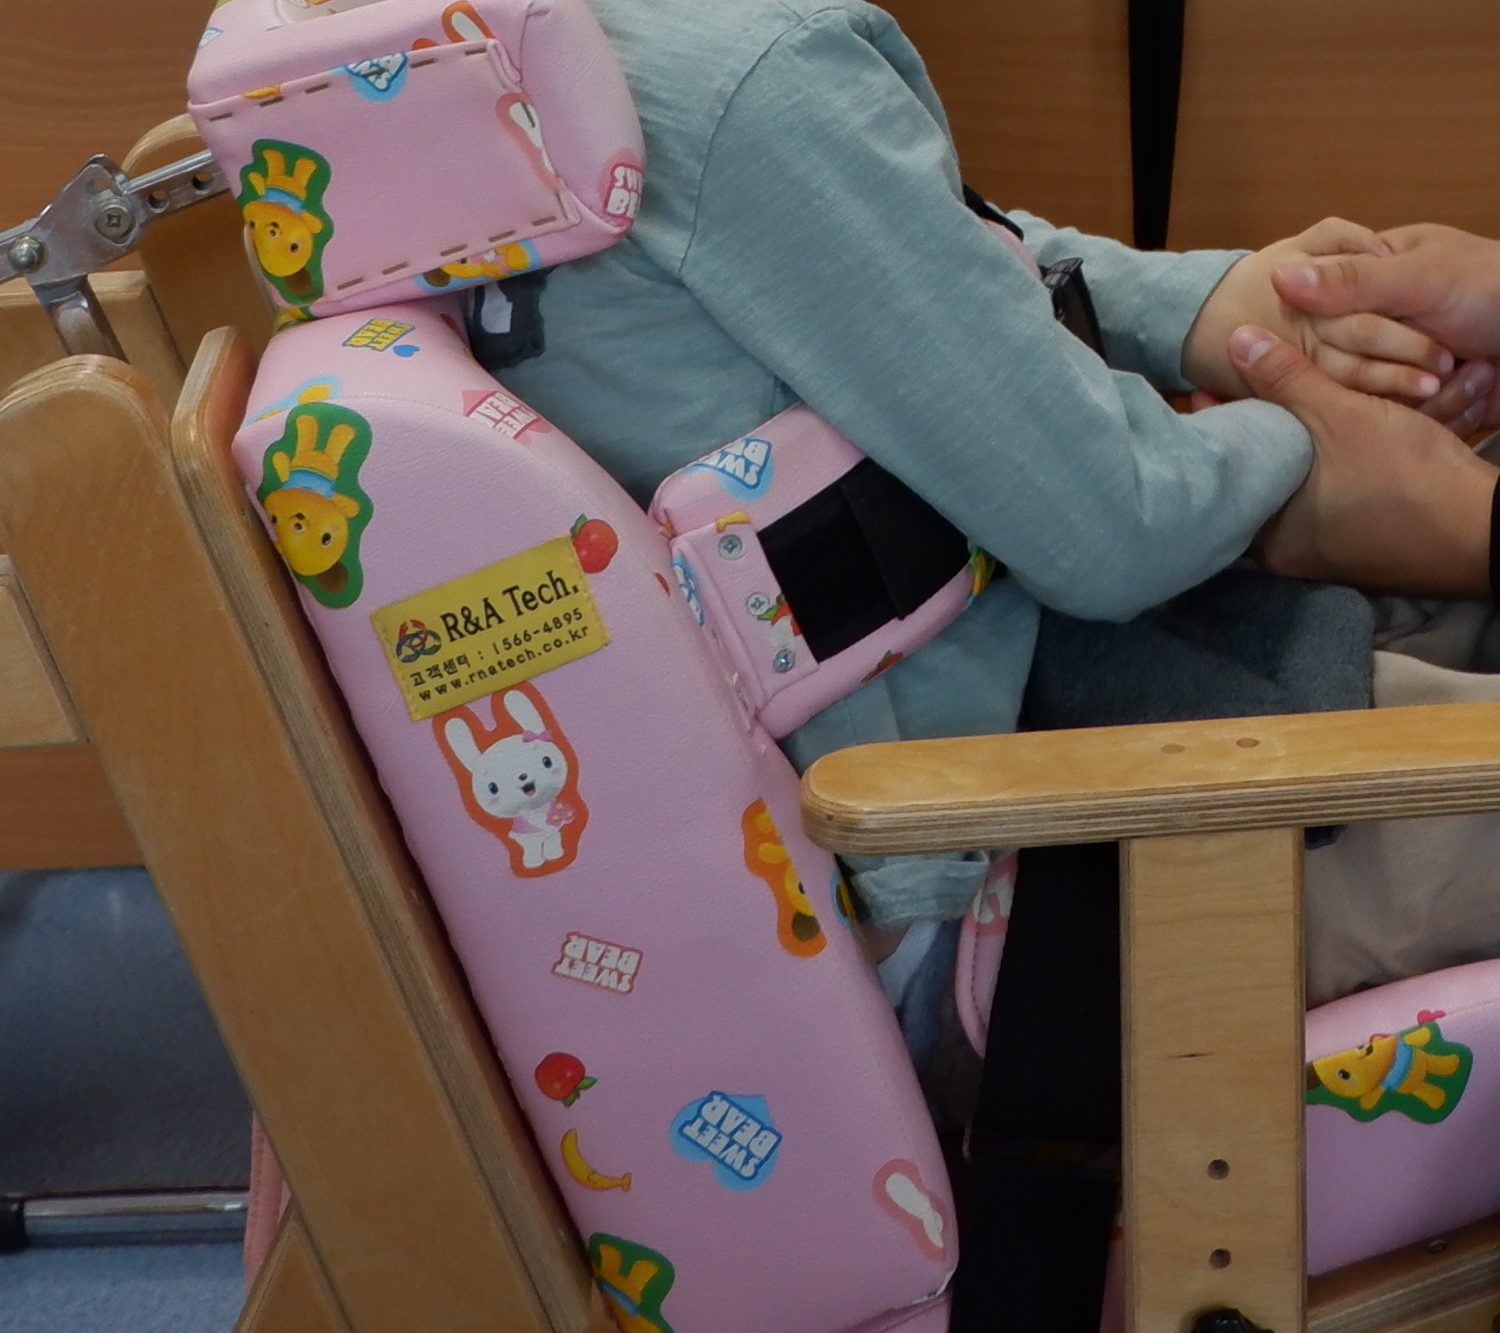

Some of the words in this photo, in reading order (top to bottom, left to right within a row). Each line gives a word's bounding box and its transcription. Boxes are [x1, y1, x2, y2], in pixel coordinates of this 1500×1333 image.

[439, 596, 506, 643] R&A
[502, 569, 580, 618] Tech.
[409, 653, 472, 687] 고객센터
[491, 607, 584, 656] 1566-4895
[418, 624, 590, 703] www.rnatech.co.kr
[553, 956, 632, 993] SWEET
[563, 935, 640, 975] BEAR
[681, 1117, 761, 1178] SWEET
[700, 1095, 779, 1161] BEAR
